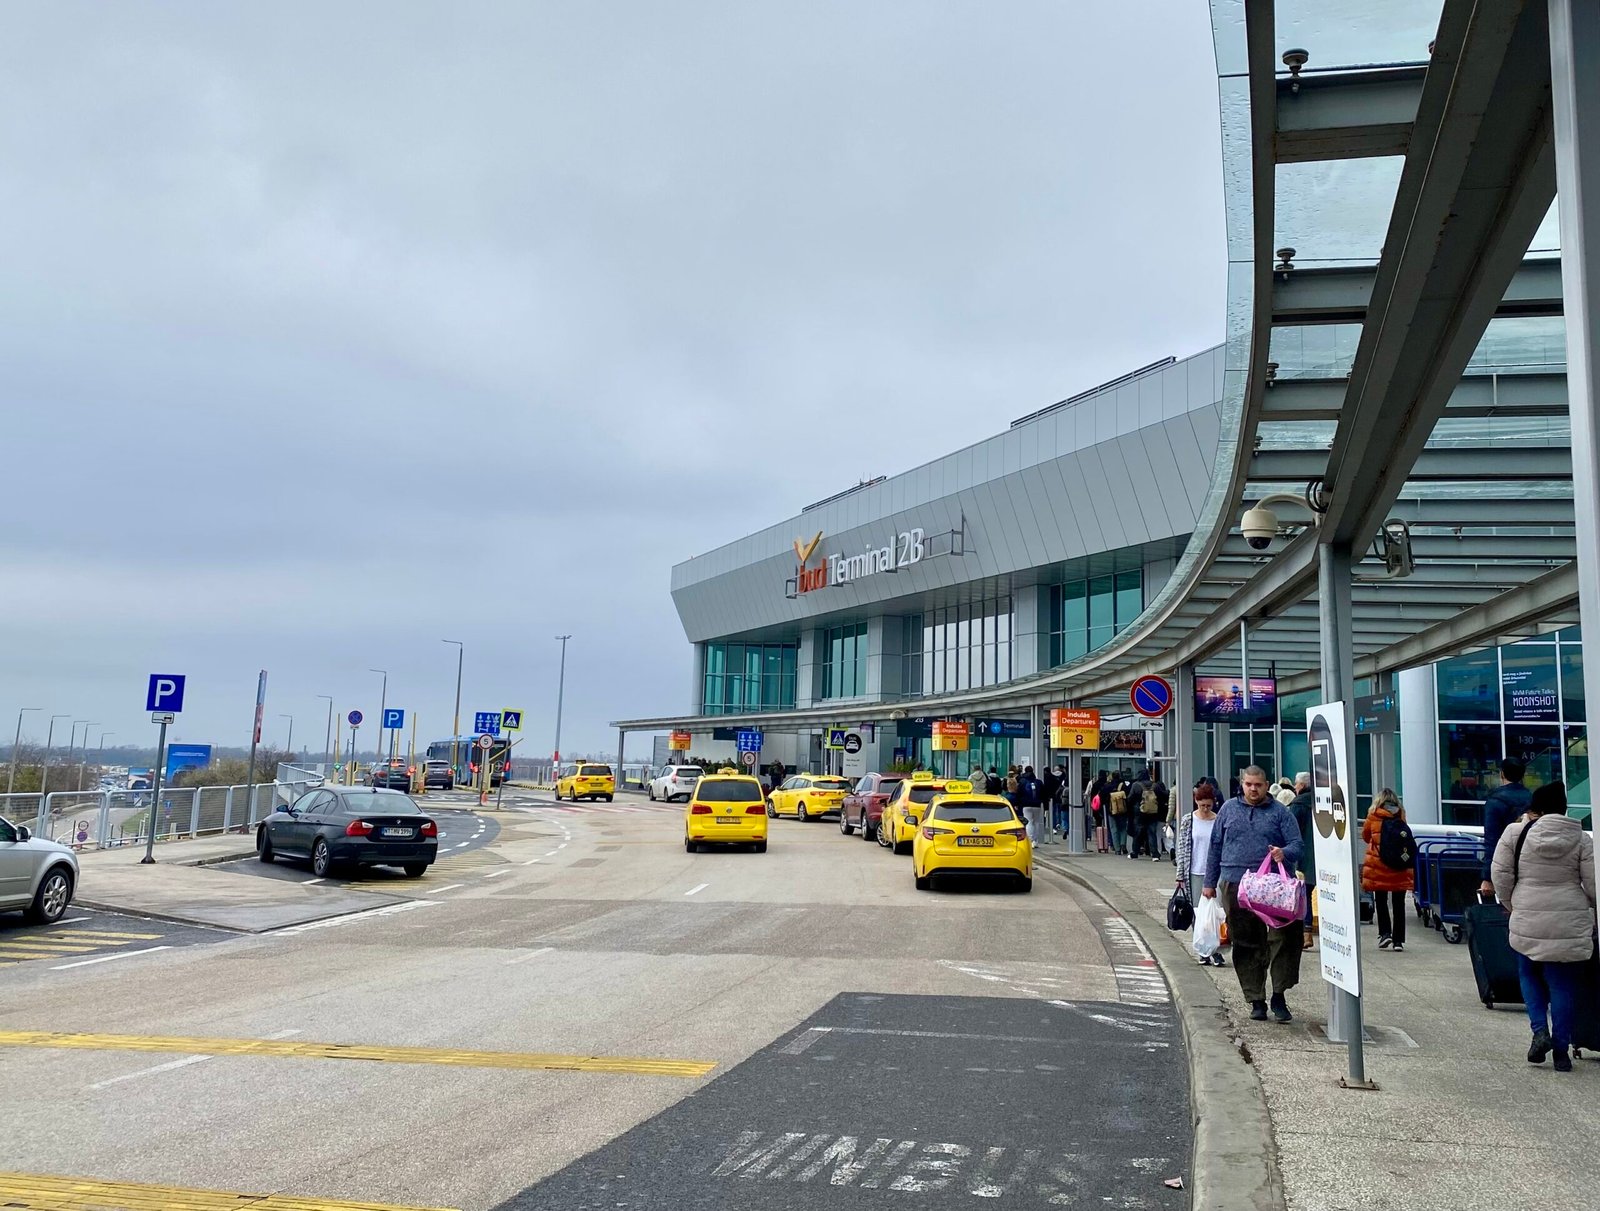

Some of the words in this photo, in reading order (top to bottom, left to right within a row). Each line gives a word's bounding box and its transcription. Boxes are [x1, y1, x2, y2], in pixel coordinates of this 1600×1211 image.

[829, 535, 895, 585] Terminal
[898, 527, 925, 567] 2B
[798, 557, 827, 593] bud
[154, 679, 176, 707] P
[1512, 695, 1556, 707] MOONSHOT
[388, 711, 400, 726] P
[951, 740, 958, 748] 9
[1075, 734, 1084, 745] 8
[1322, 936, 1337, 951] minibus
[1336, 941, 1346, 957] drop
